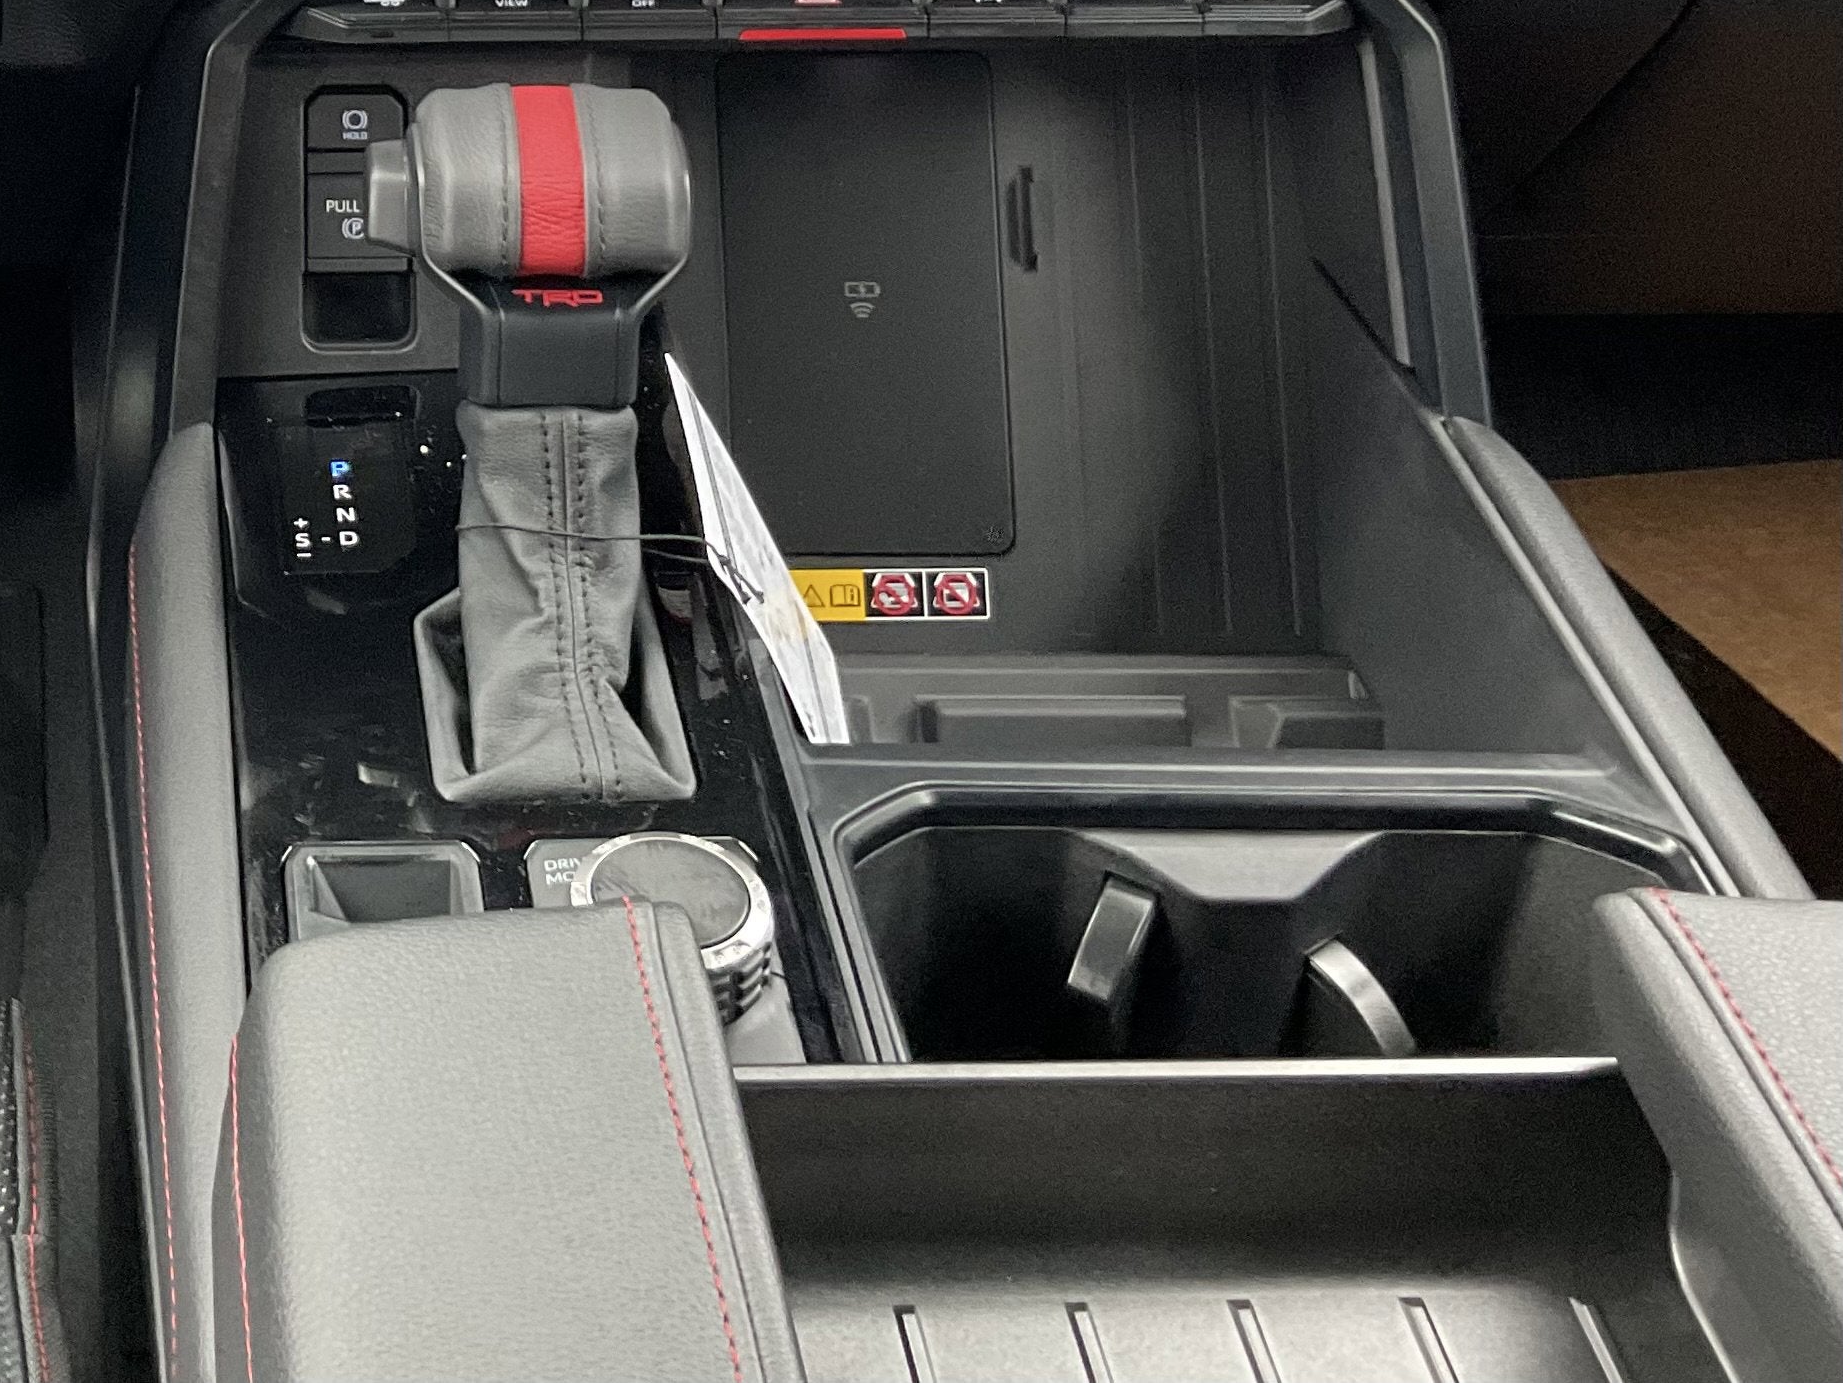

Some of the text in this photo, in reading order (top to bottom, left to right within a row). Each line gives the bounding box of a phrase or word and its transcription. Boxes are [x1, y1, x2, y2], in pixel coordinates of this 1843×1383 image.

[494, 0, 529, 7] VIEW
[631, 0, 655, 7] OFF
[325, 199, 361, 213] PULL
[511, 288, 604, 307] TRD
[330, 460, 351, 478] P
[332, 484, 352, 499] R
[335, 507, 356, 523] N
[295, 530, 360, 548] S D
